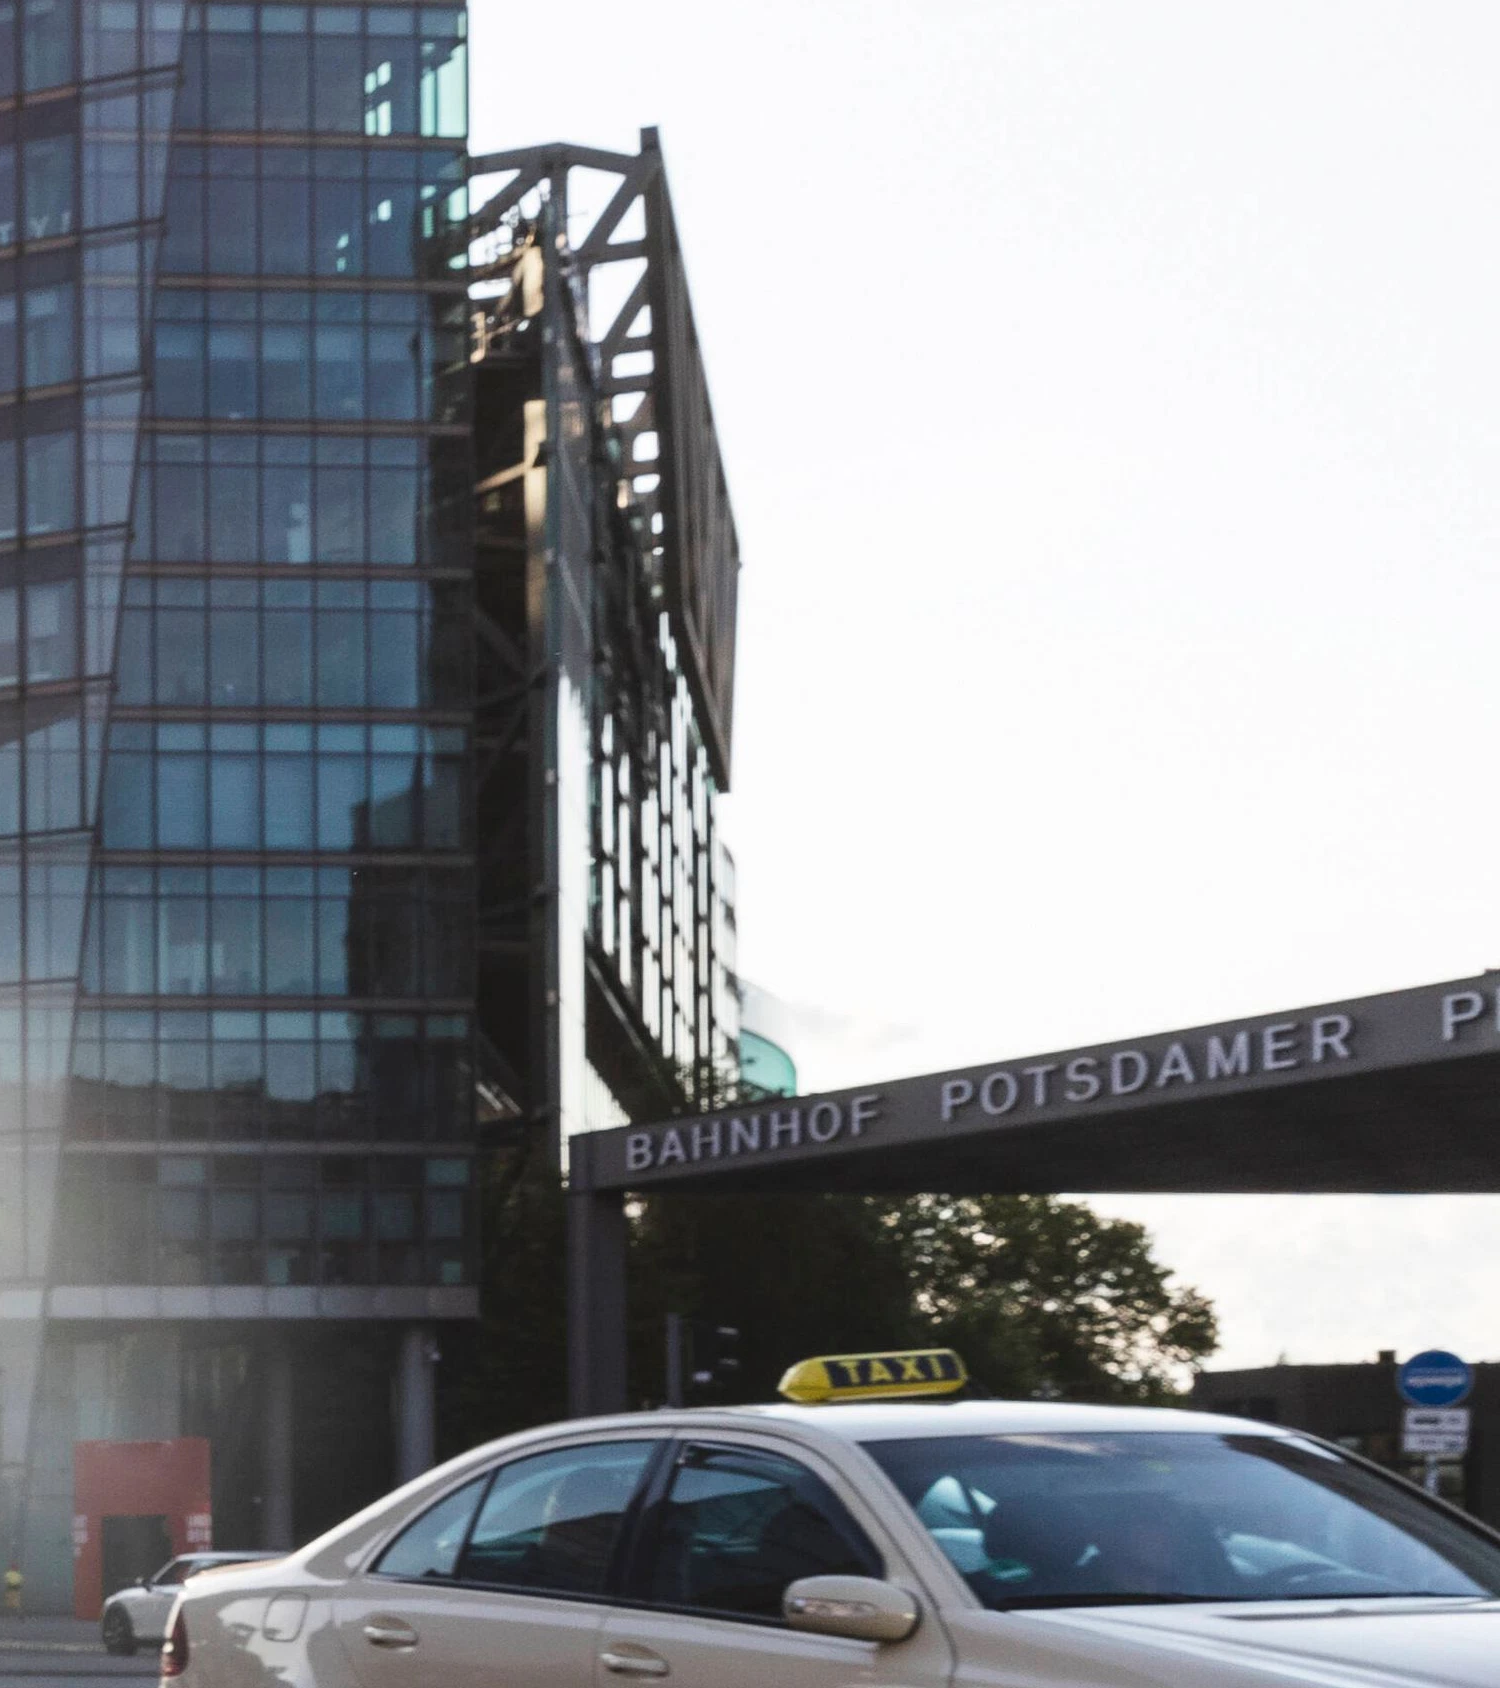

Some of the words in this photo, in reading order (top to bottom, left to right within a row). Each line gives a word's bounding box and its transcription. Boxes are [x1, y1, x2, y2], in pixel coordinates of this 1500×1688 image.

[626, 1094, 879, 1171] BAHNHOF
[940, 1013, 1352, 1121] POTSDAMER
[836, 1354, 943, 1384] TAXI
